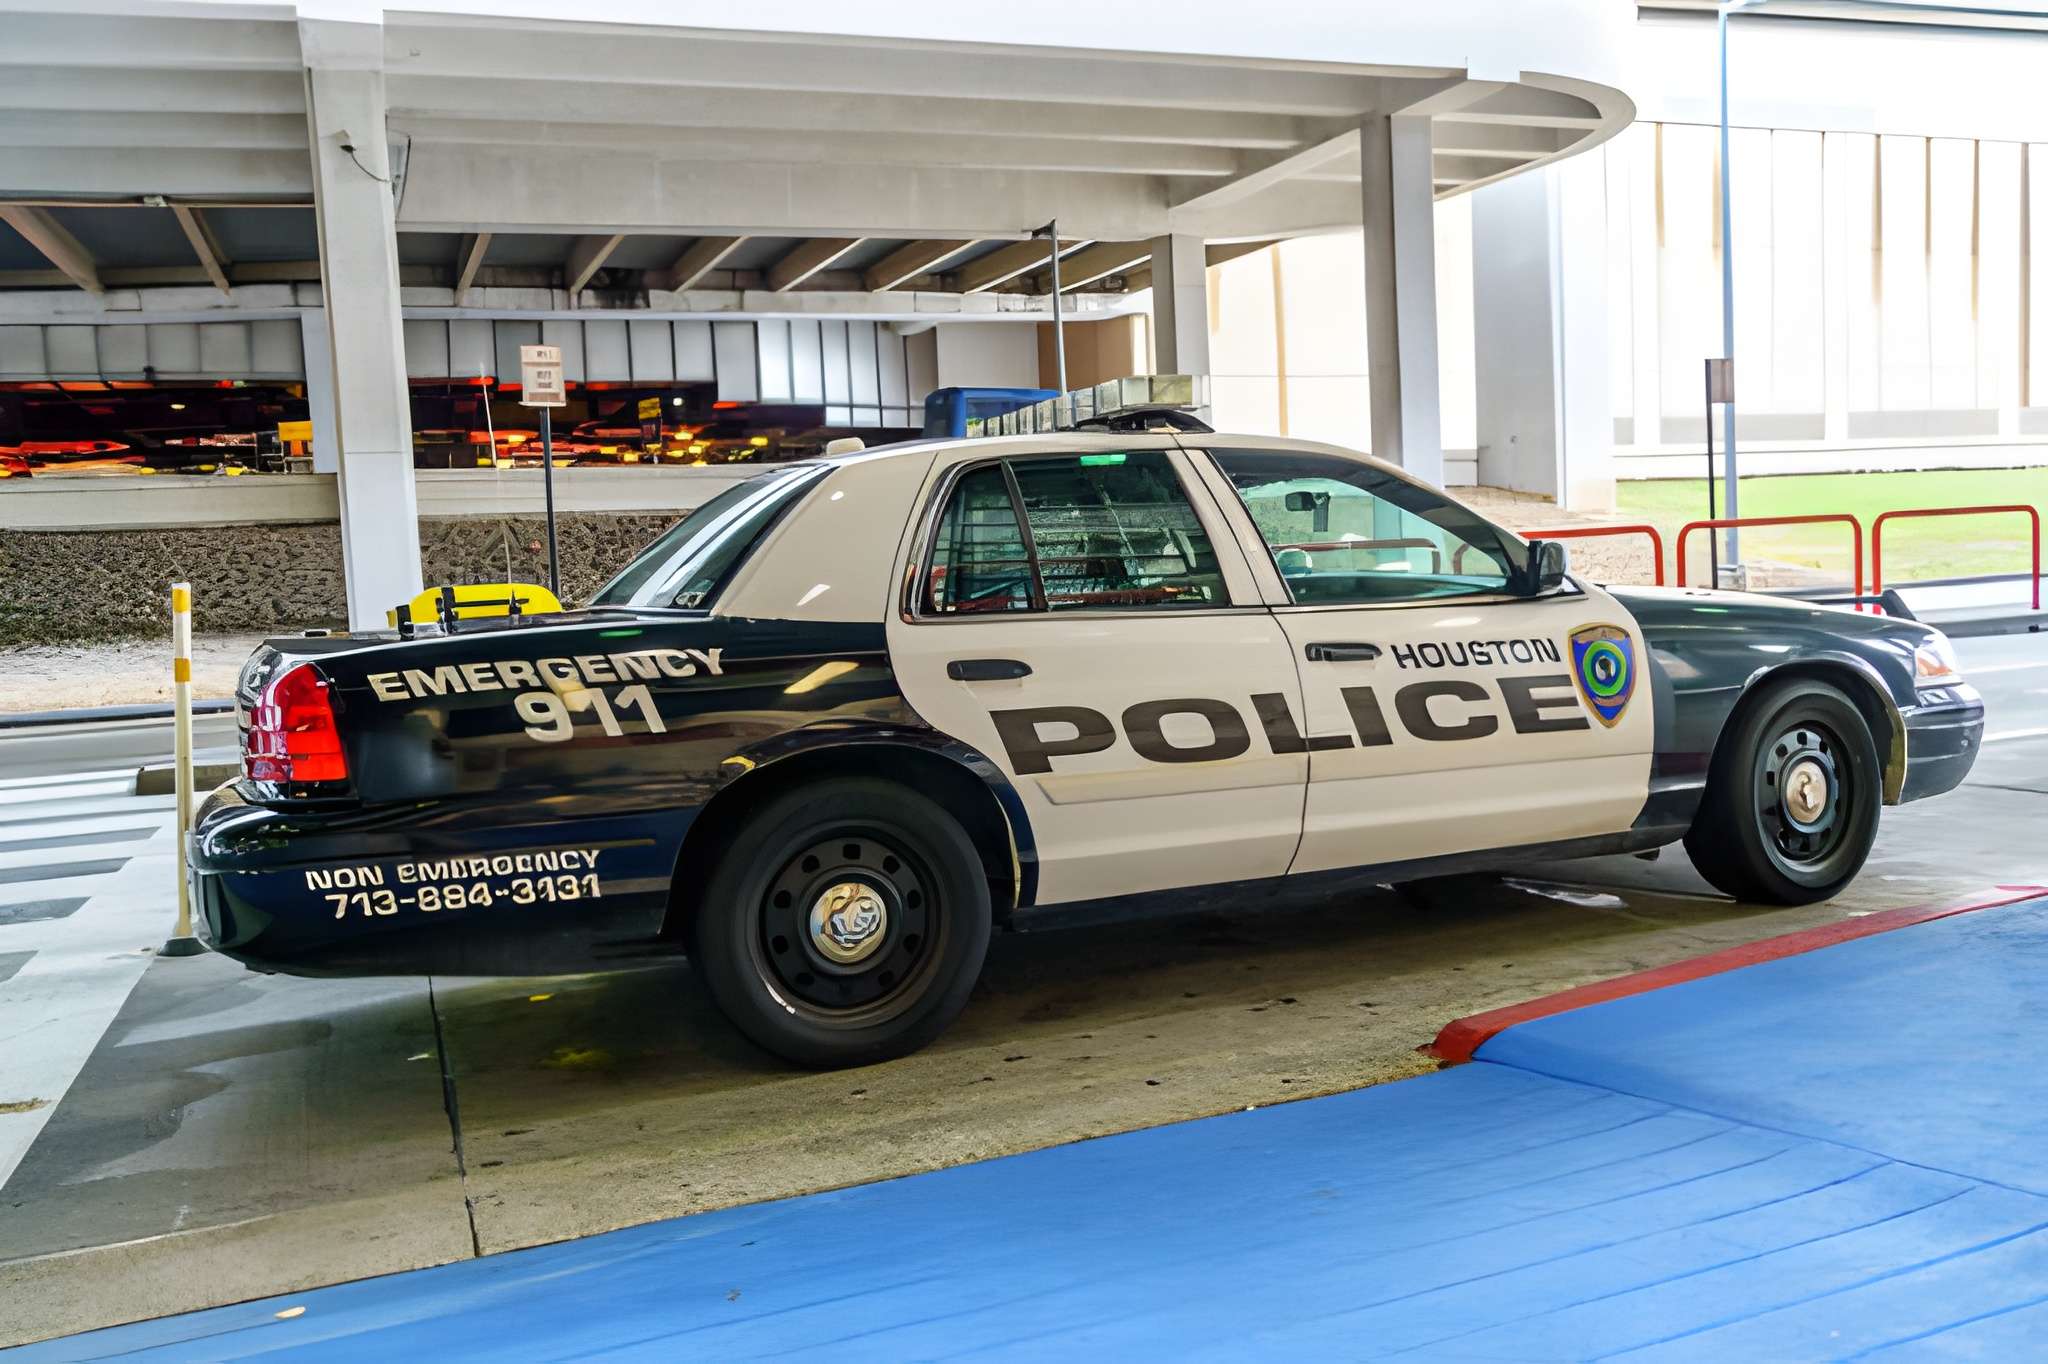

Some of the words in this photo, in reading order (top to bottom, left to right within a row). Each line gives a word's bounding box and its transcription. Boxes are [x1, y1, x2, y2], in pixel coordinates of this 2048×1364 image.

[366, 648, 724, 702] EMERGENCY
[1390, 638, 1562, 669] HOUSTON
[513, 684, 668, 743] 911
[988, 674, 1592, 776] POLICE
[305, 865, 384, 891] NON
